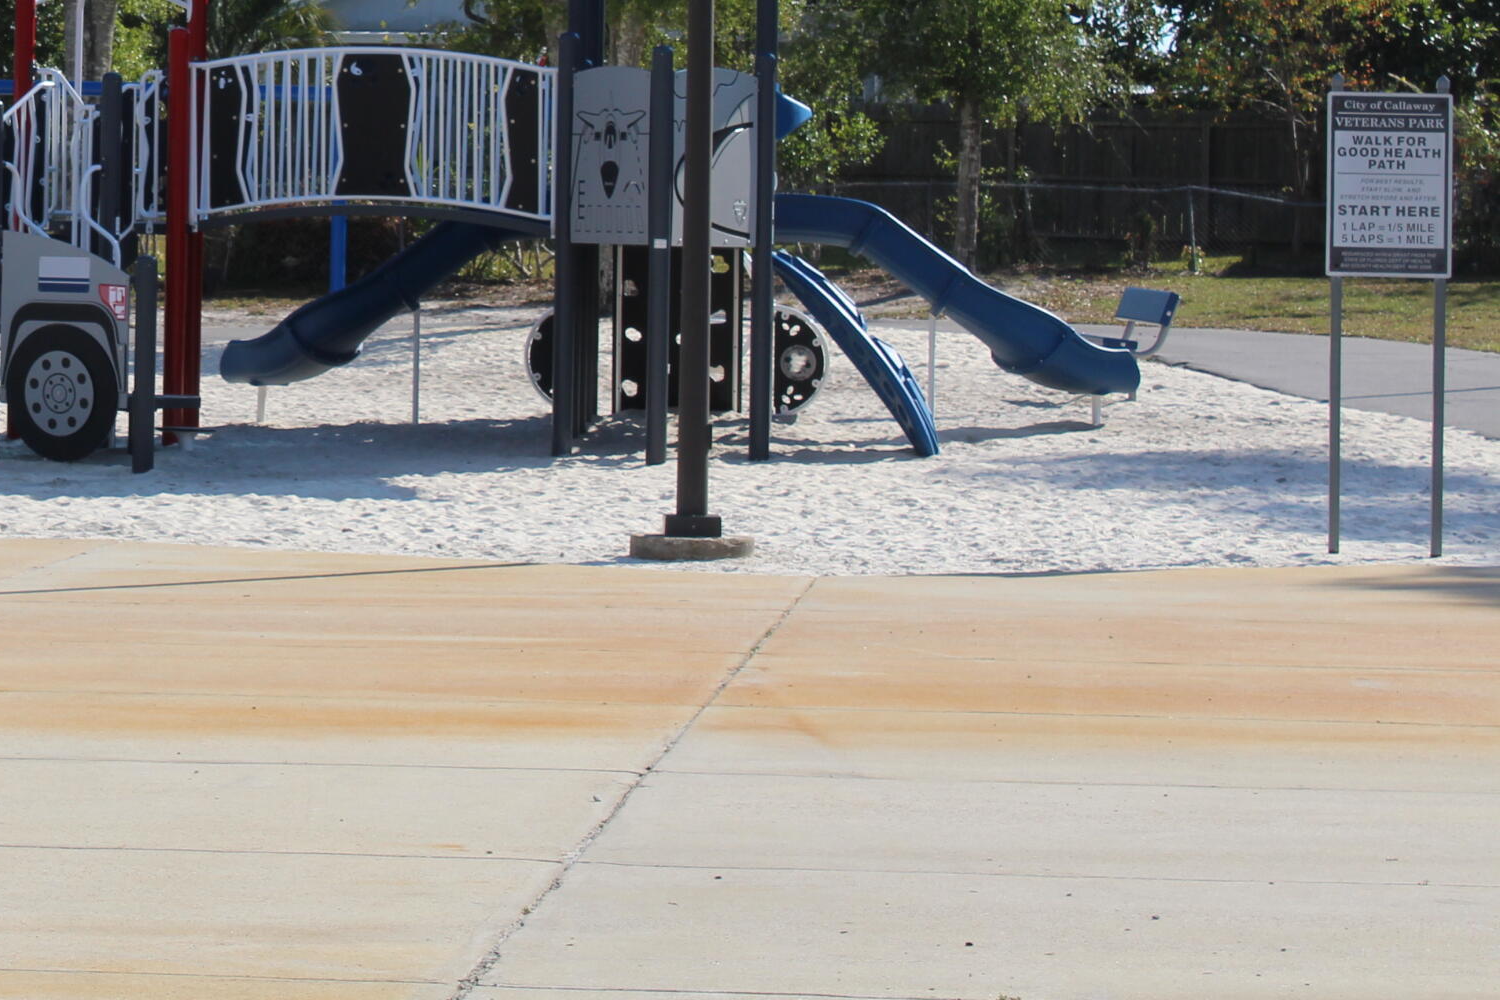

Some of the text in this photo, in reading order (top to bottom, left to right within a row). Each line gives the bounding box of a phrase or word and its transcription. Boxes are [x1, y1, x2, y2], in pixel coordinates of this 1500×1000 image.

[1344, 100, 1436, 112] City of Callaway
[1335, 117, 1445, 129] VETERANS PARK
[1352, 135, 1427, 146] WALK FOR
[1337, 147, 1441, 158] GOOD HEALTH
[1368, 160, 1405, 169] PATH
[1338, 204, 1440, 217] START HERE
[1342, 222, 1347, 231] 1
[1351, 222, 1375, 231] LAP
[1388, 223, 1403, 232] 1/5
[1406, 223, 1435, 232] MILE
[1341, 234, 1348, 243] 5
[1351, 234, 1384, 244] LAPS
[1397, 235, 1402, 244] 1
[1406, 235, 1435, 244] MILE
